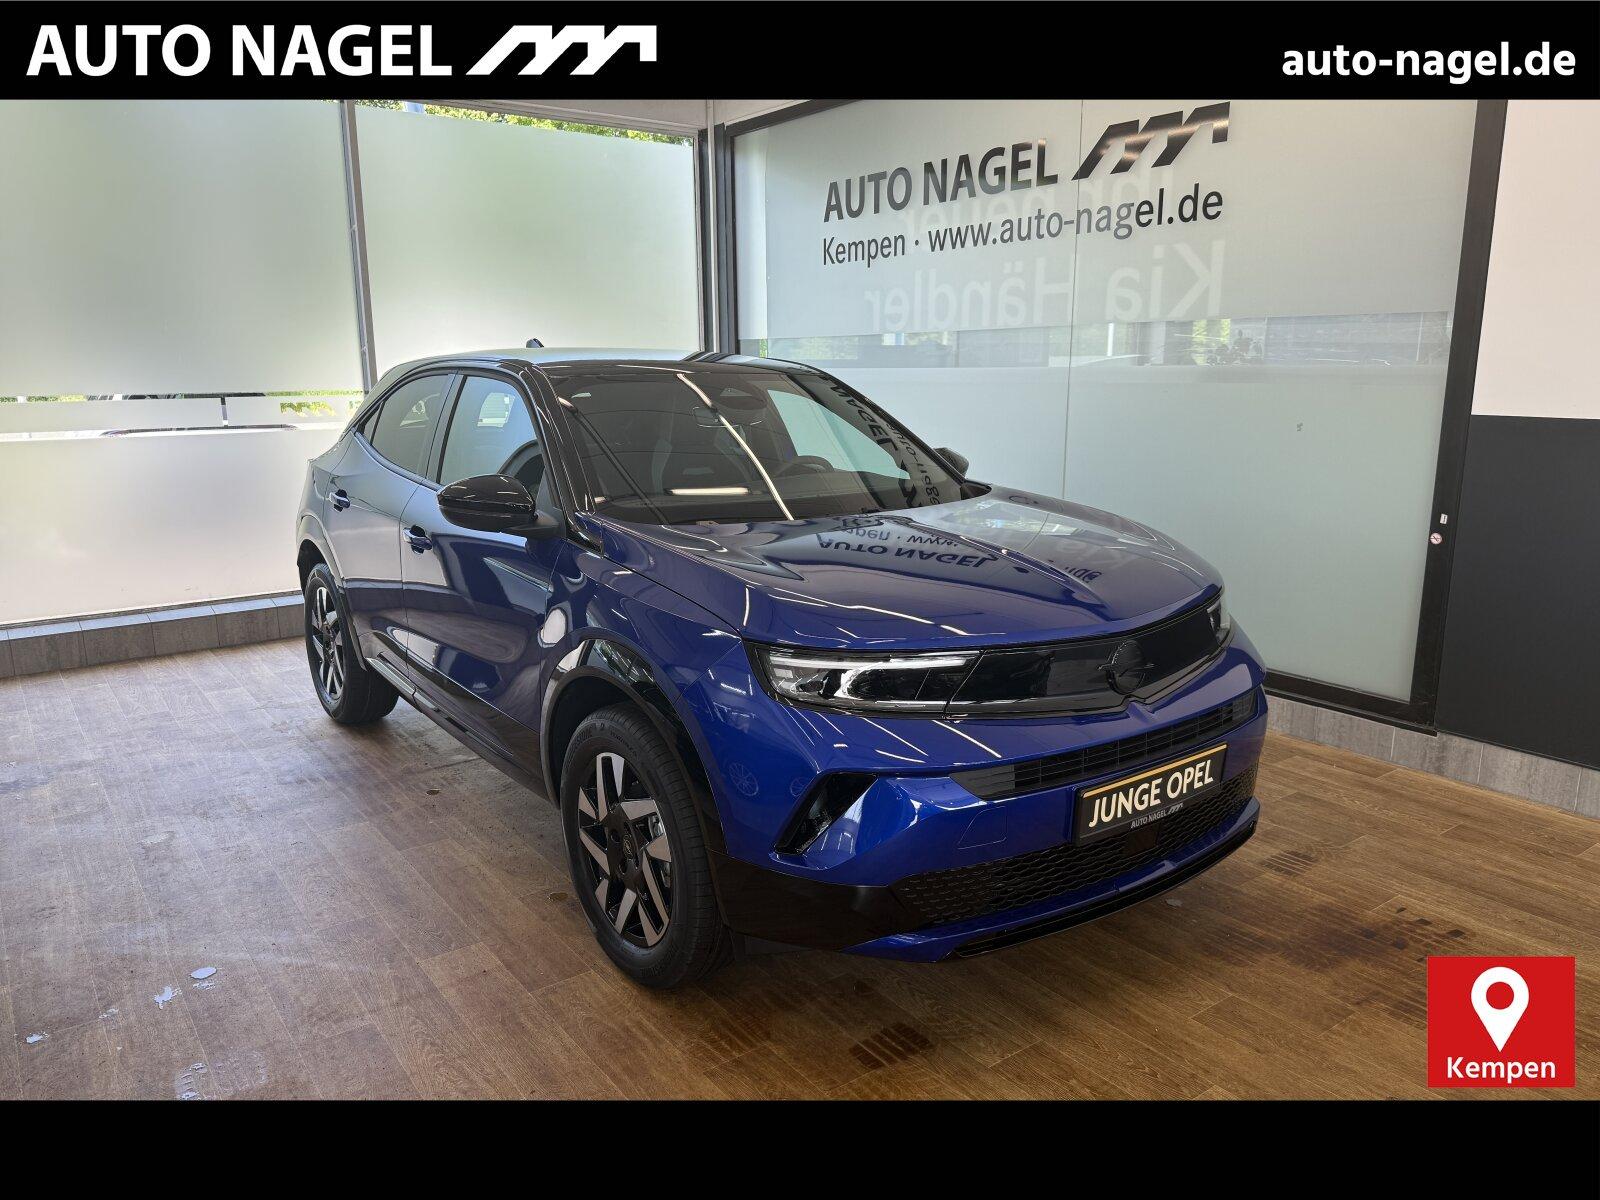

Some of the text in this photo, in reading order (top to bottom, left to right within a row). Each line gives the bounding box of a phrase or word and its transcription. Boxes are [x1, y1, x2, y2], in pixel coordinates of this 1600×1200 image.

[823, 138, 1059, 223] AUTO NAGEL
[822, 183, 1224, 268] Kempen www.auto-nagel.de
[1088, 759, 1214, 828] JUNGE OPEL
[1130, 809, 1167, 829] AUTO NAGEL
